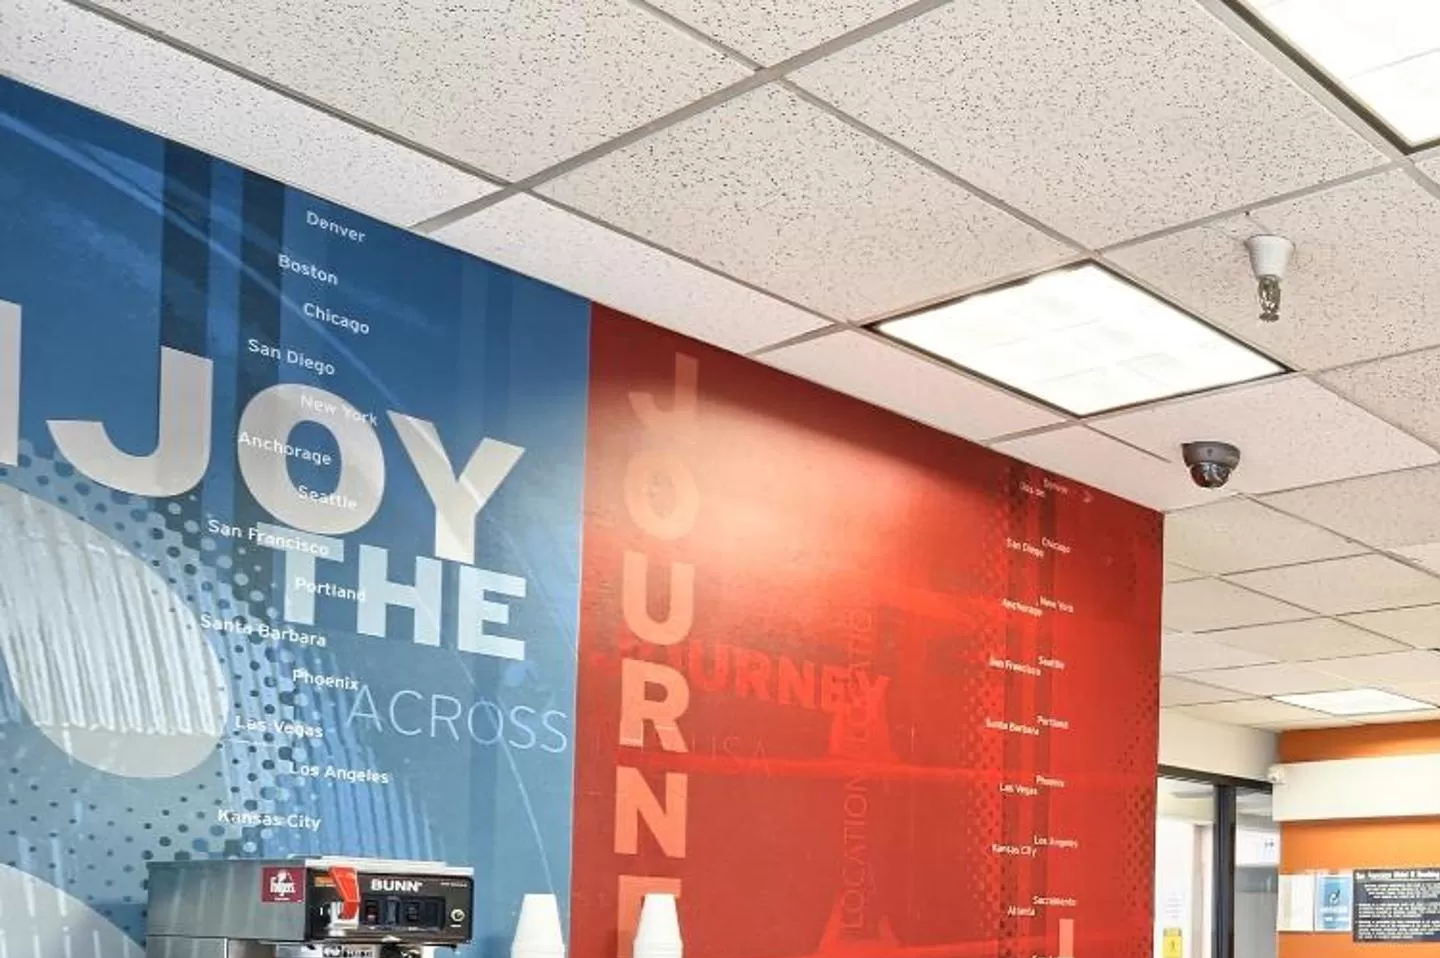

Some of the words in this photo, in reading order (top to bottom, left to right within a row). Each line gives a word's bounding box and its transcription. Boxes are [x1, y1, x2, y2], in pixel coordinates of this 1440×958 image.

[306, 211, 366, 243] Denver
[278, 254, 338, 285] Boston
[303, 302, 370, 335] Chicago
[248, 339, 281, 360] San
[286, 348, 336, 376] Diego
[300, 394, 337, 415] New
[342, 402, 378, 427] York
[0, 300, 526, 565] JOY
[238, 431, 332, 466] Anchorage
[296, 484, 358, 510] Seattle
[208, 520, 243, 539] San
[248, 527, 330, 556] Francisco
[257, 522, 527, 661] THE
[295, 576, 367, 602] Portland
[200, 613, 253, 634] Santa
[258, 624, 328, 648] Barbara
[292, 668, 359, 692] Phoenix
[234, 714, 267, 733] Las
[273, 720, 324, 740] Vegas
[345, 684, 570, 754] ACROSS
[289, 760, 320, 779] Los
[324, 764, 390, 786] Angeles
[217, 808, 282, 828] Kansas
[286, 812, 322, 833] City
[370, 878, 420, 893] BUNN
